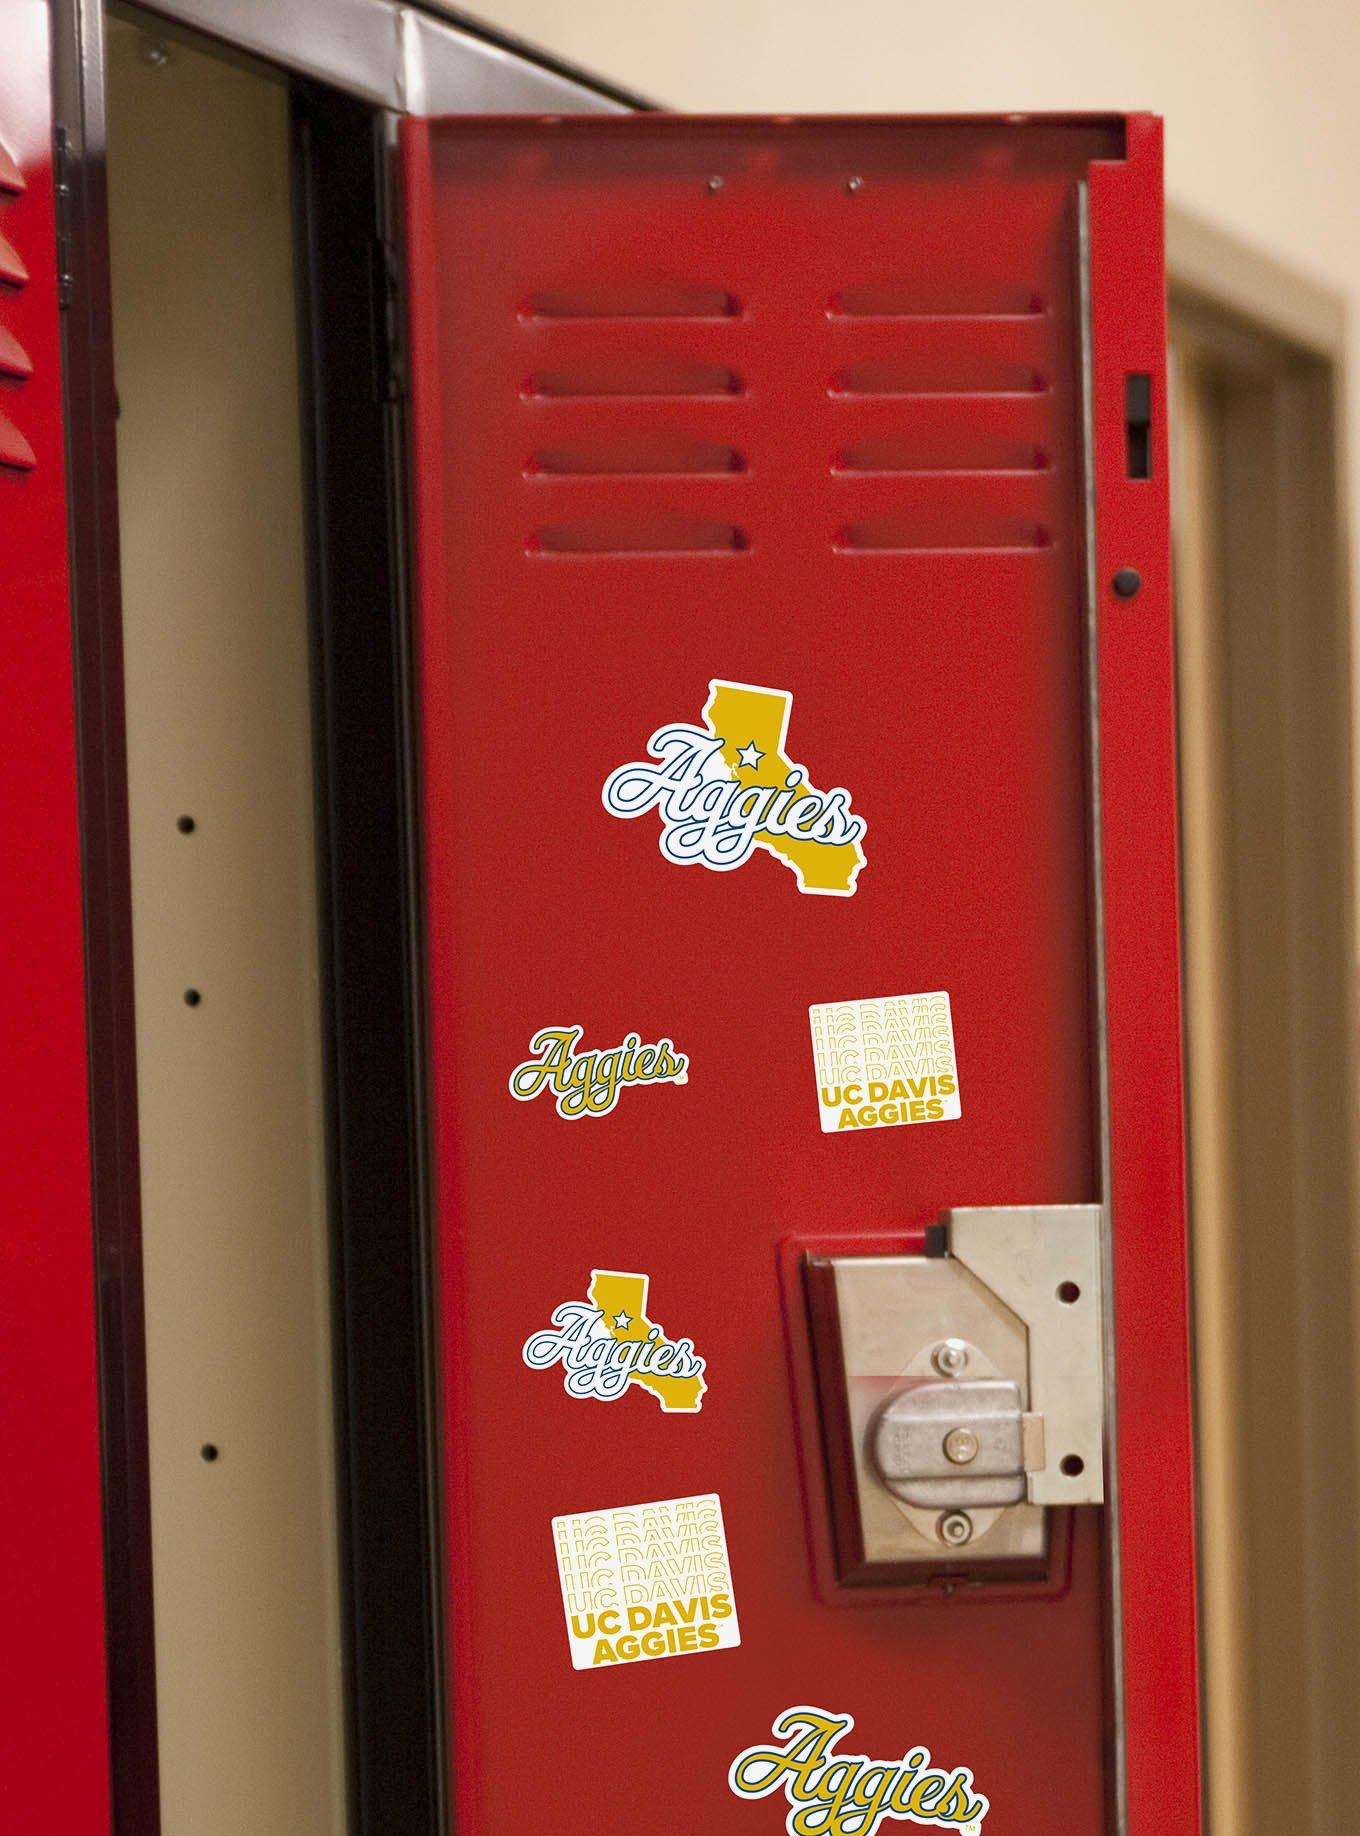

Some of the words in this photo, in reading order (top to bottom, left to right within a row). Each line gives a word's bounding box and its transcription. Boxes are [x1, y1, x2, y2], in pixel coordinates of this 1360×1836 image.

[608, 729, 861, 865] Aggies
[513, 1029, 685, 1115] Aggies
[821, 1084, 864, 1107] UC
[868, 1074, 956, 1103] DAVIS
[866, 1056, 955, 1081] DAVIS
[837, 1098, 945, 1130] AGGIES
[526, 1305, 702, 1398] Aggies
[624, 1571, 730, 1605] DAVIS
[571, 1609, 622, 1639] UC
[627, 1593, 732, 1631] DAVIS
[592, 1623, 721, 1665] AGGIES
[735, 1712, 983, 1836] Aggies
